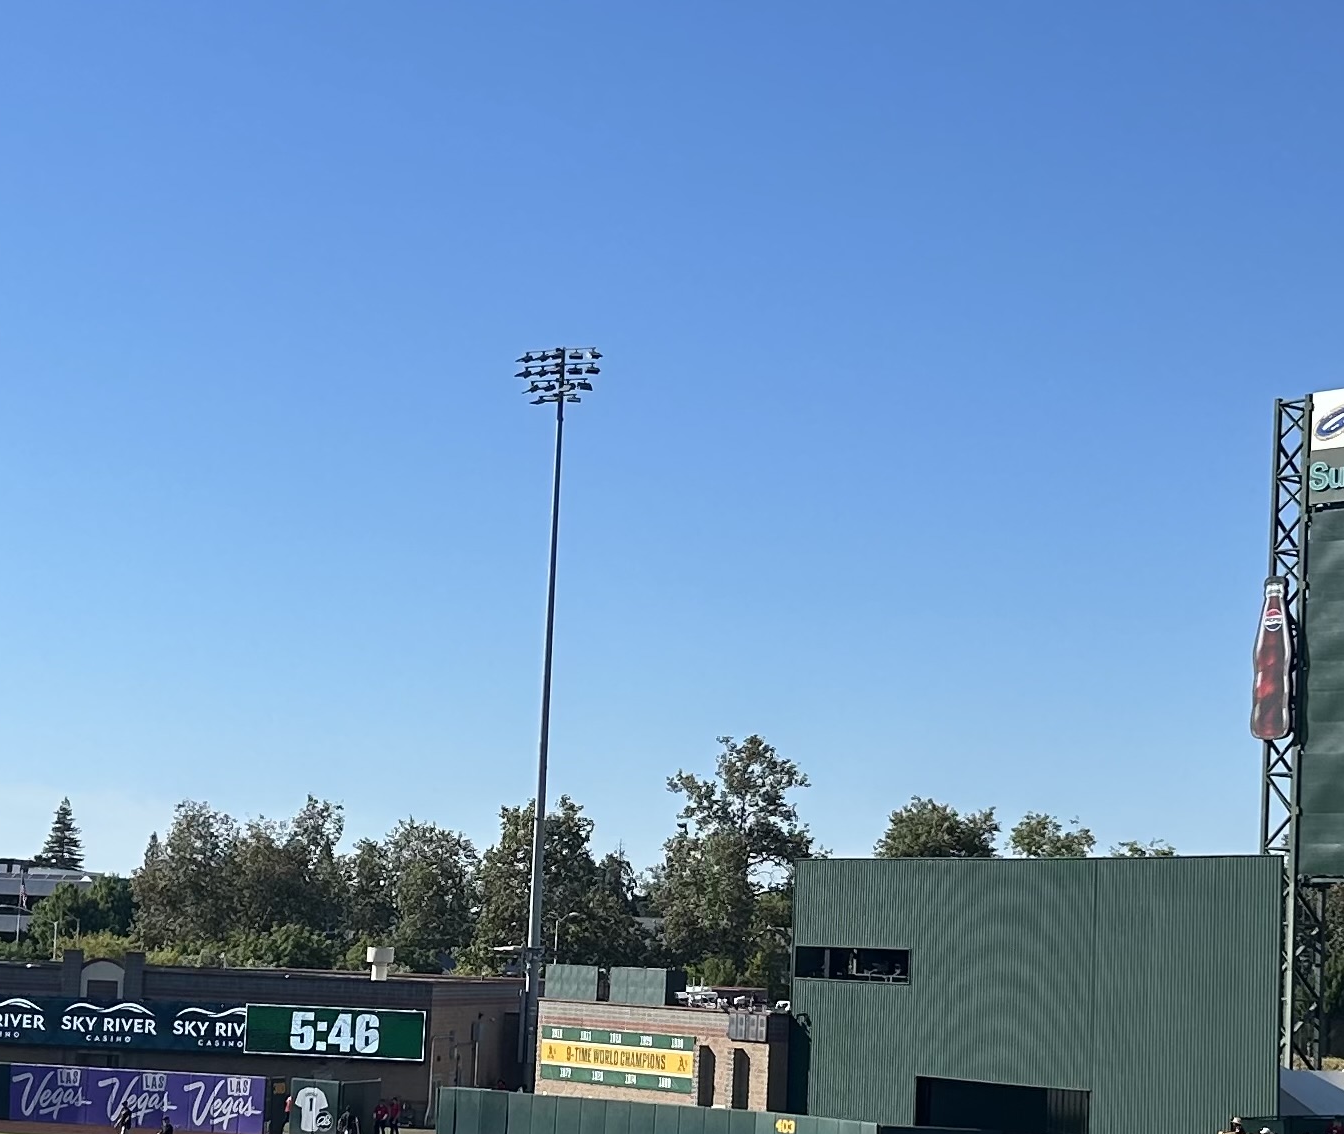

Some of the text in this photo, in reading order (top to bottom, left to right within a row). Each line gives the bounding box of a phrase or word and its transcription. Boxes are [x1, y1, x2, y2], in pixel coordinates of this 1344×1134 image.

[61, 1015, 157, 1036] SKY RIVER
[172, 1020, 245, 1037] SKY RIV
[289, 1011, 379, 1053] 5:46
[86, 1034, 131, 1043] CASINO
[198, 1038, 244, 1048] CASINO
[594, 1049, 618, 1065] WORLD
[620, 1050, 666, 1070] CHAMPIONS
[59, 1070, 78, 1085] LAS
[145, 1075, 164, 1090] LAS
[228, 1079, 249, 1094] LAS
[12, 1071, 92, 1120] Vegas
[98, 1076, 177, 1126] Vegas
[184, 1079, 262, 1130] Vegas
[775, 1119, 796, 1134] 403
